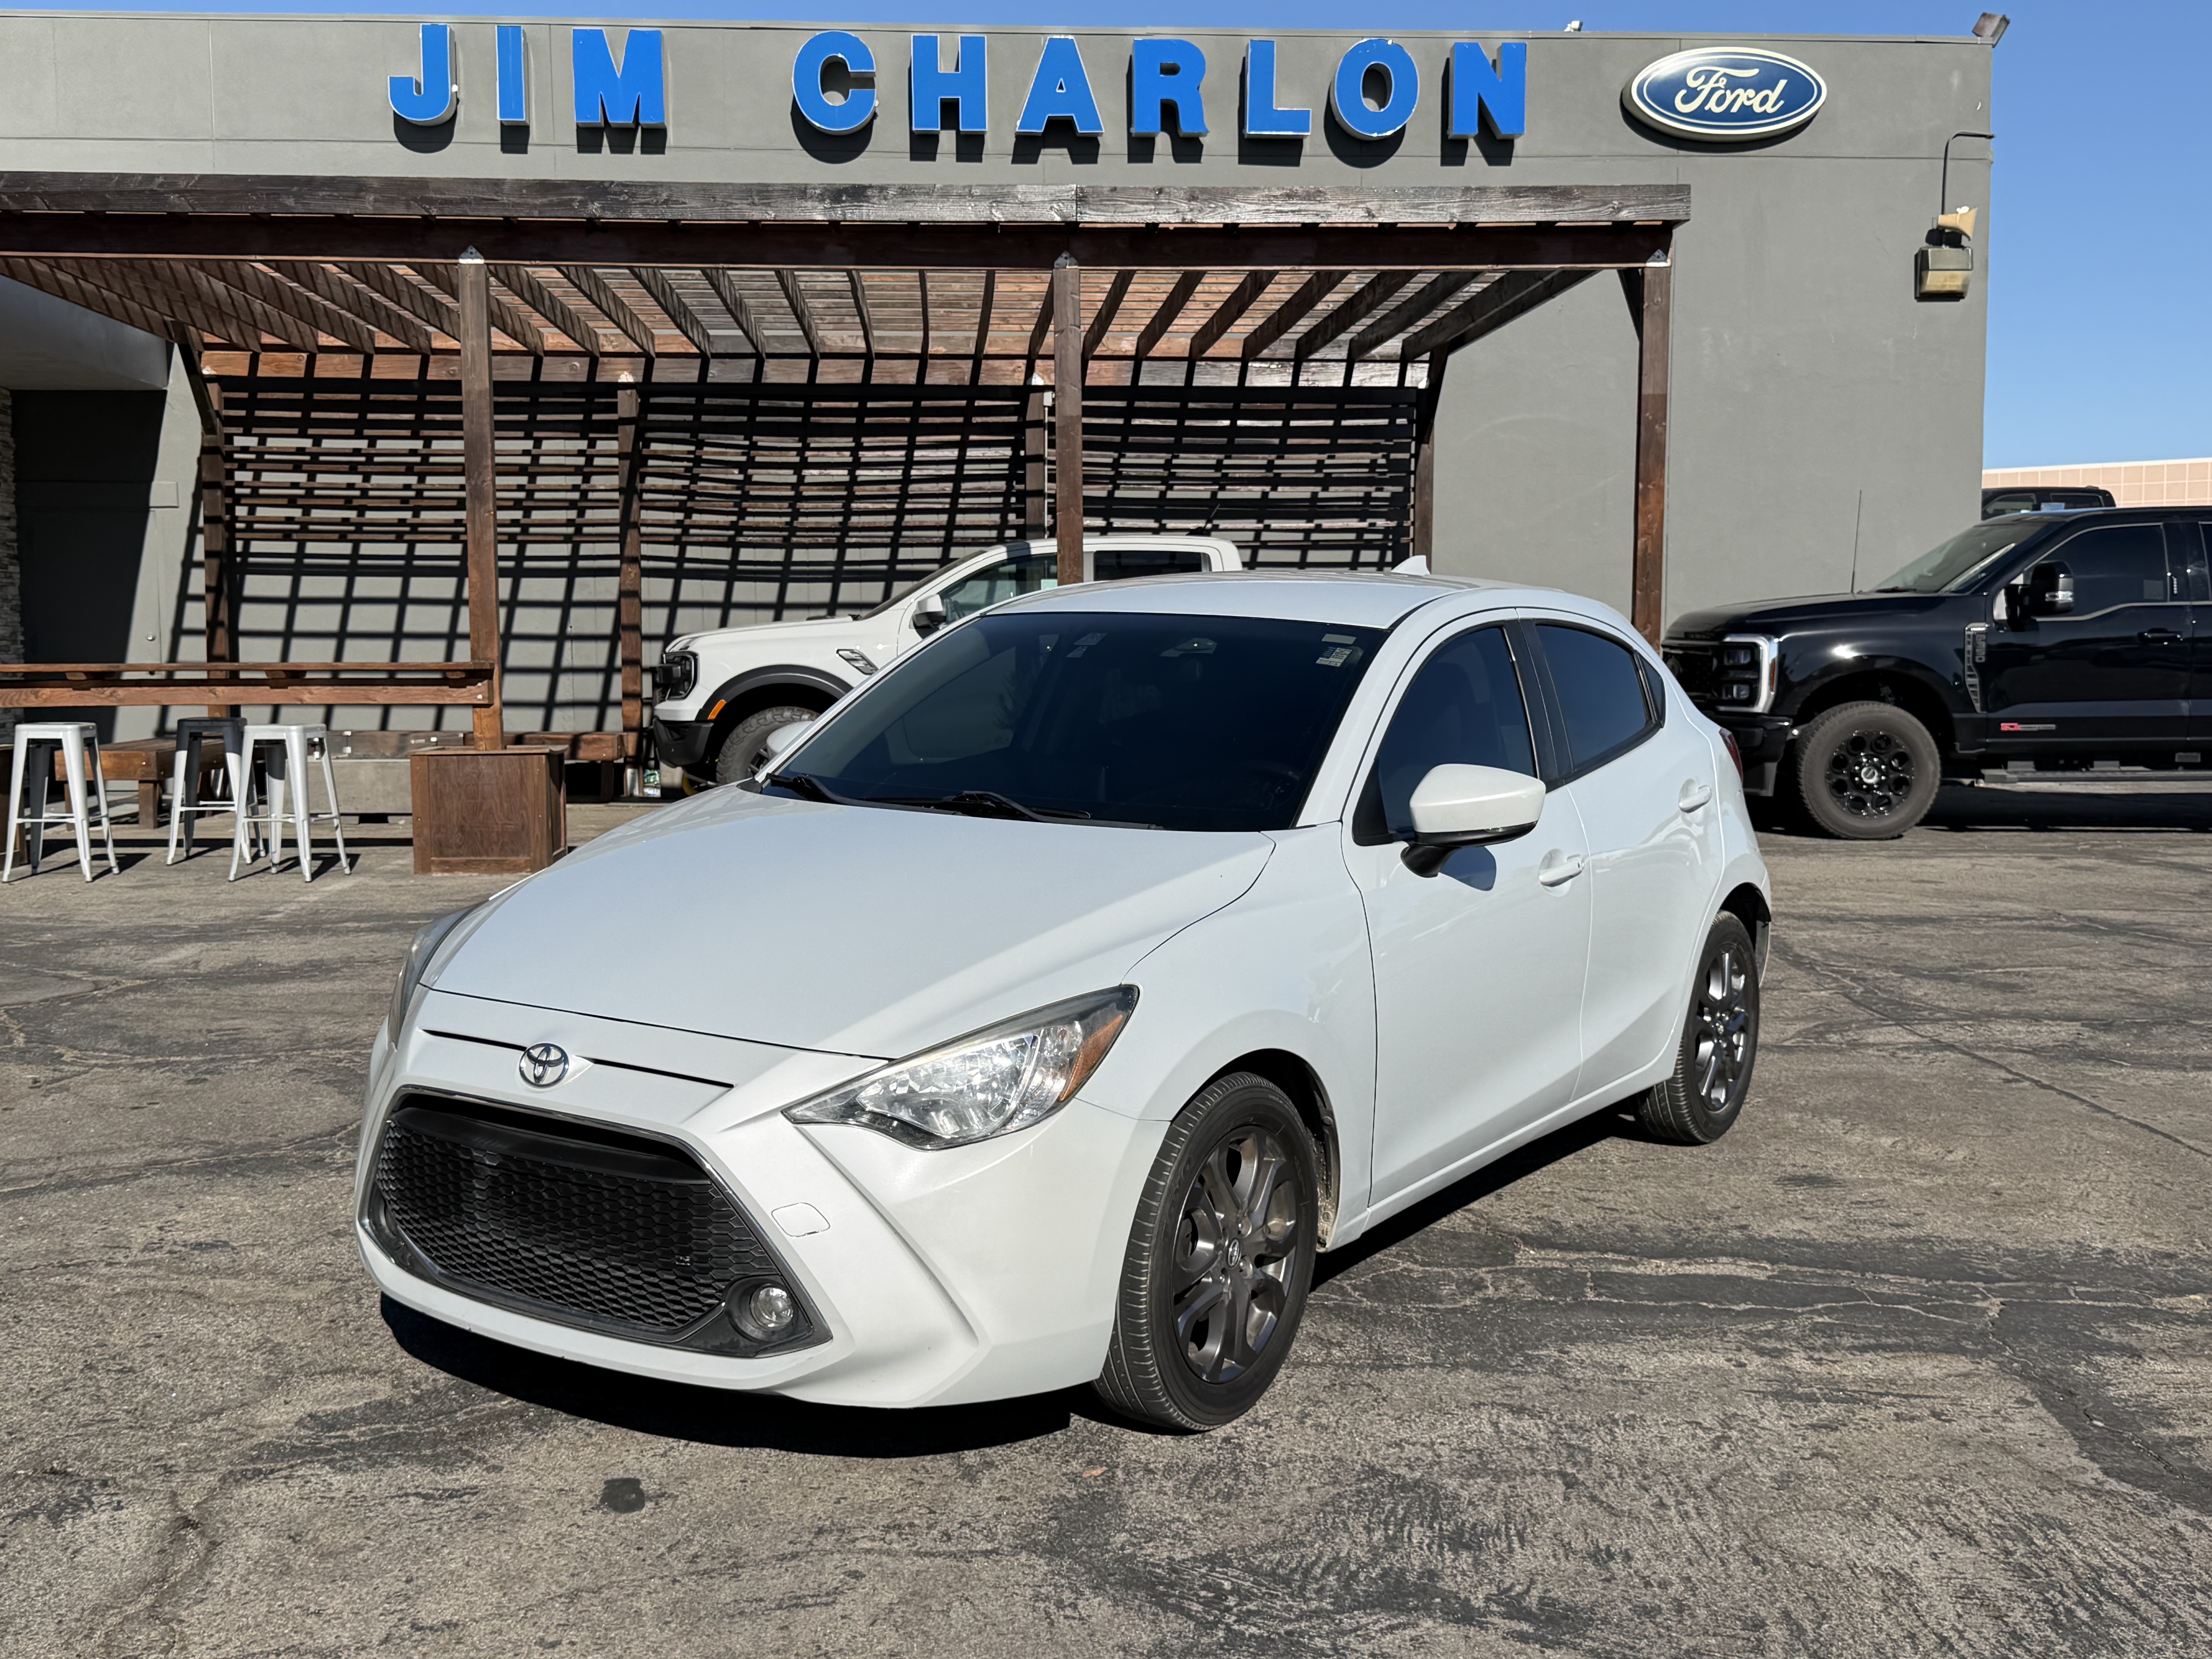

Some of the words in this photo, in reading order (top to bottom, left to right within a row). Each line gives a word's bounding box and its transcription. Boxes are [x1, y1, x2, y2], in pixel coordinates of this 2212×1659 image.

[388, 23, 665, 124] JIM
[792, 31, 1528, 136] CHARLON
[1674, 66, 1789, 113] Ford
